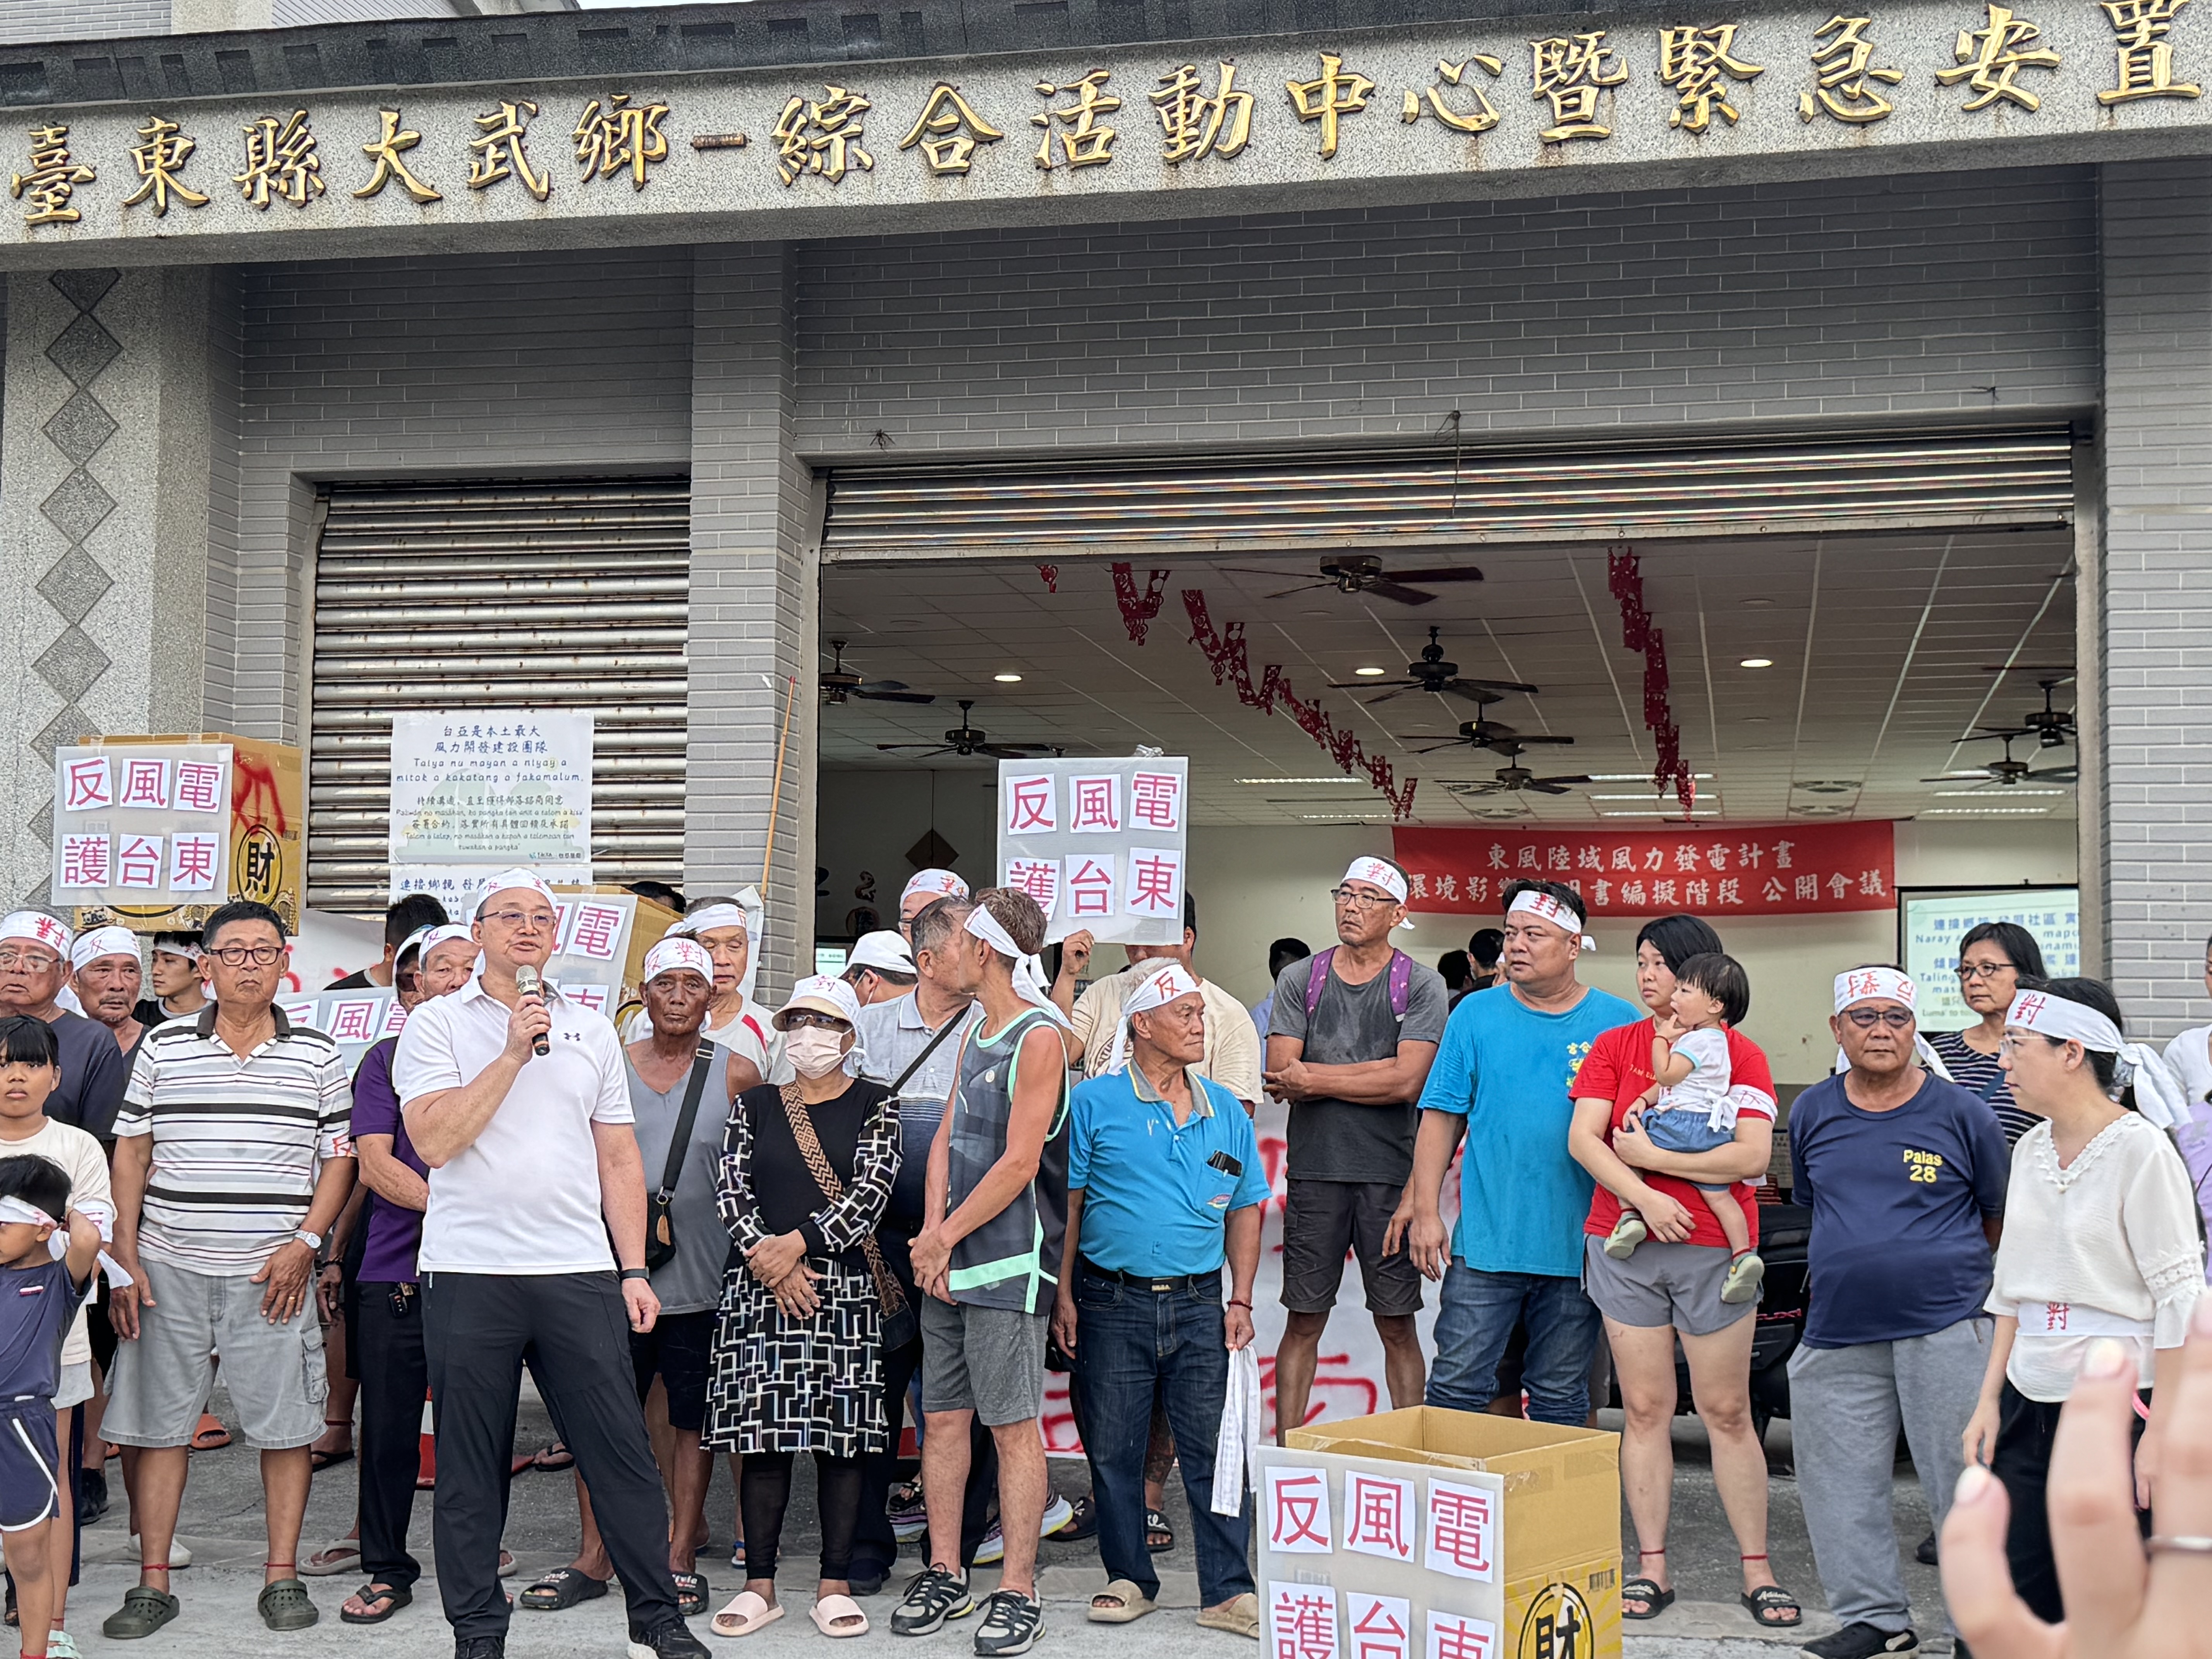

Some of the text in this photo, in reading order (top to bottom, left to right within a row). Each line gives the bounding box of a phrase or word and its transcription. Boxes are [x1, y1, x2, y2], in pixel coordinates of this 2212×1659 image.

[67, 759, 220, 810] 反風電
[1009, 773, 1178, 830] 反風電
[64, 836, 215, 884] 護台東
[244, 841, 275, 894] 財
[1487, 840, 1795, 873] 東風陸域風力發電計畫
[1762, 869, 1886, 901] 公開會議
[1154, 971, 1181, 1000] 反
[1910, 1164, 1937, 1183] 28
[1272, 1475, 1490, 1571] 反風電
